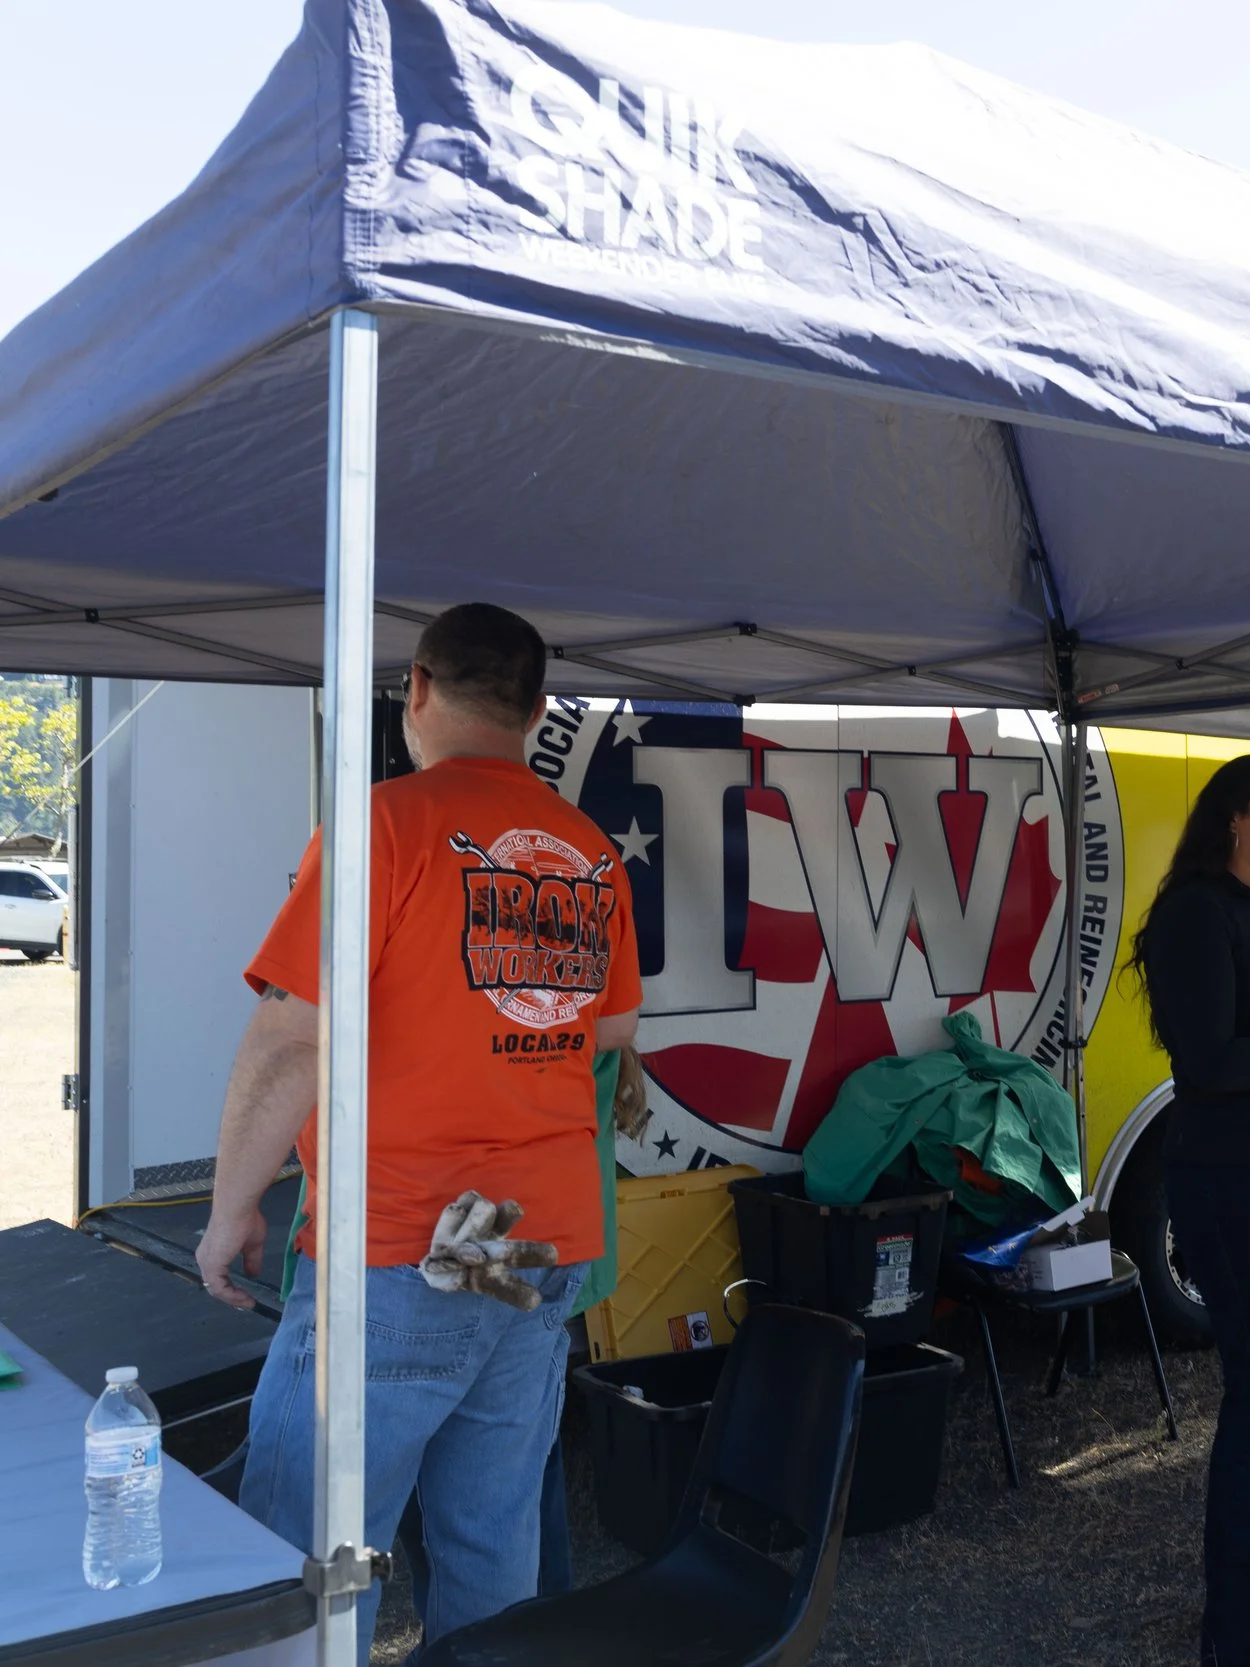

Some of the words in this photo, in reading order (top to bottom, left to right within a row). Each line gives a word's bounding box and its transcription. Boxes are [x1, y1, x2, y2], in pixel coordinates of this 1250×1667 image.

[510, 70, 758, 195] QUIK
[515, 154, 764, 271] SHADE
[632, 745, 1044, 1016] IW
[1084, 822, 1108, 882] AND
[466, 871, 615, 954] IRON
[467, 948, 609, 989] WORKERS
[555, 1032, 585, 1050] 29
